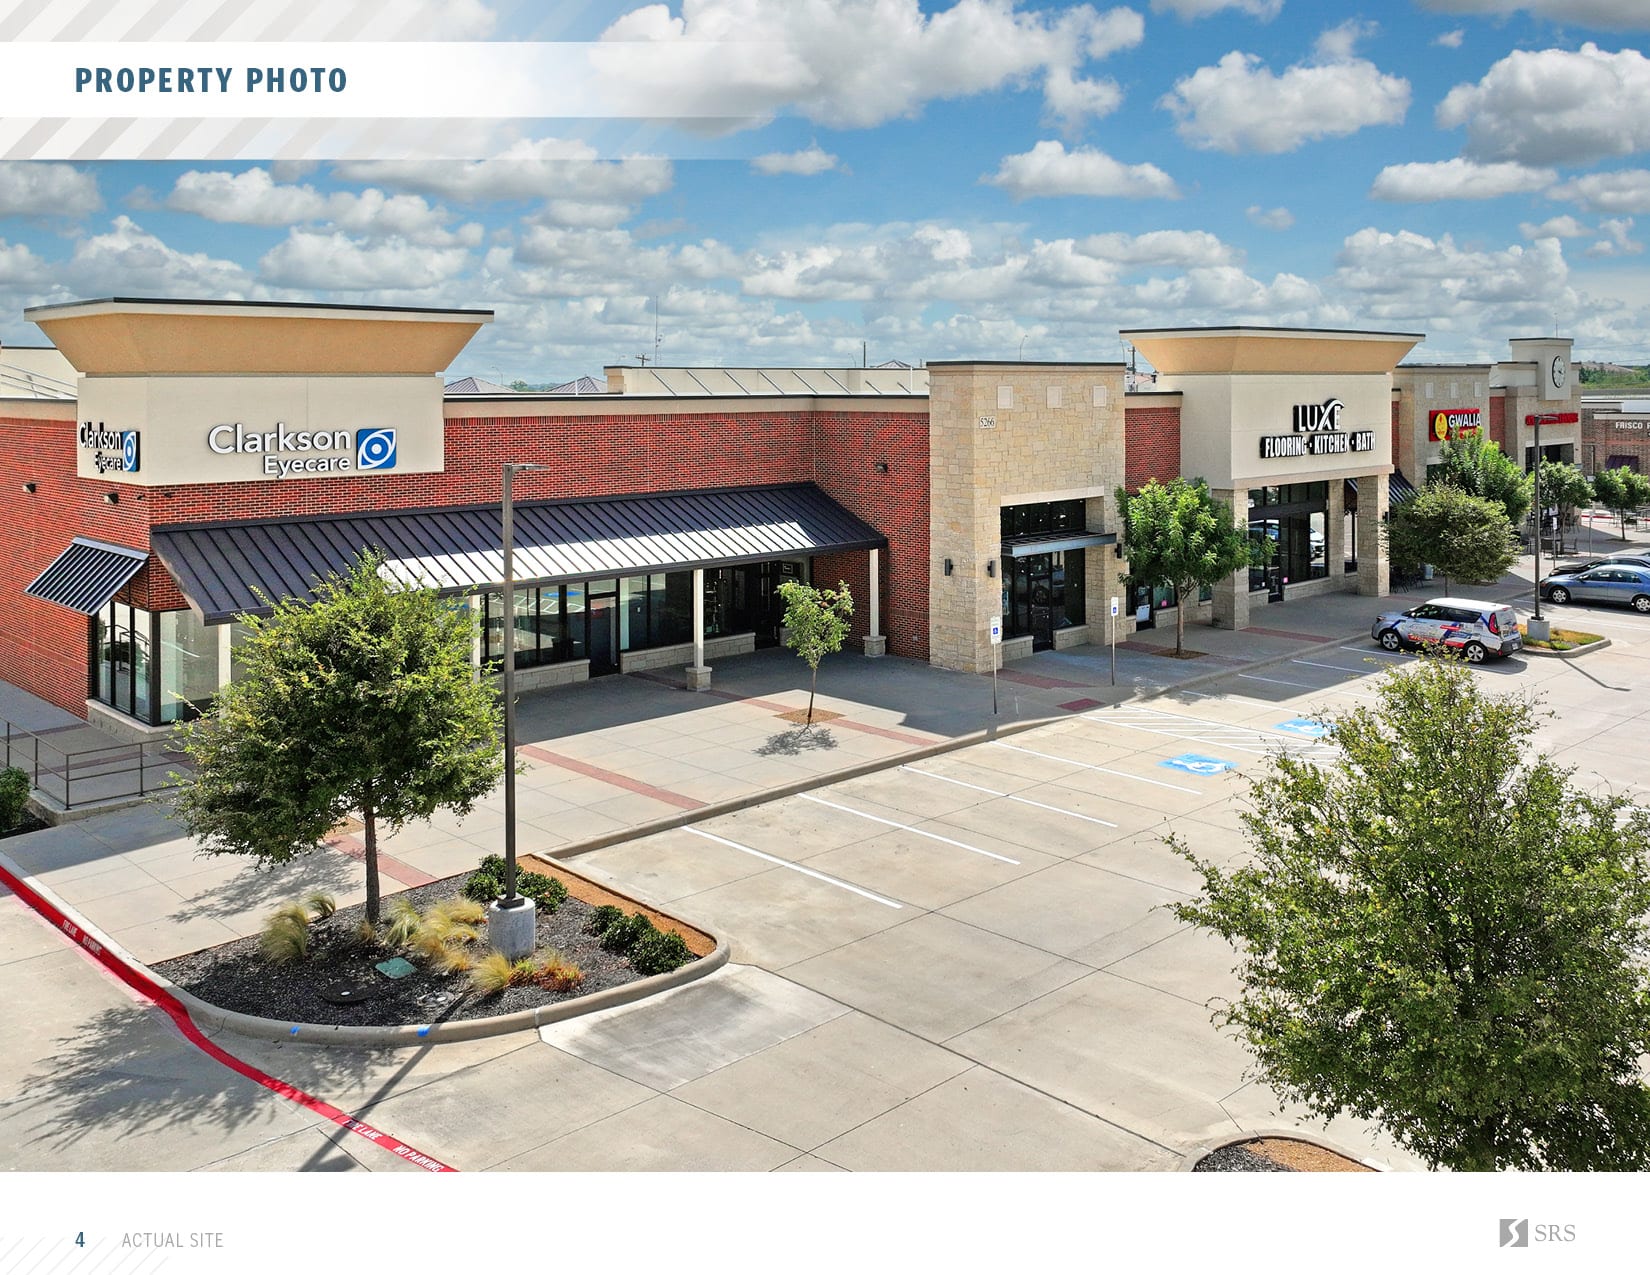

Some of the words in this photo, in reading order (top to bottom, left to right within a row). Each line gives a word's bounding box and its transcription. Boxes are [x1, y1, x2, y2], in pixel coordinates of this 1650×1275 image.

[1294, 398, 1344, 432] LUXE
[1448, 413, 1481, 428] GWALIA
[1615, 421, 1643, 429] FRISCO
[79, 421, 122, 450] Clarkson
[208, 422, 351, 454] Clarkson
[1262, 435, 1306, 458] FLOORING
[1312, 433, 1350, 454] KITCHEN
[1355, 431, 1375, 451] BATH
[95, 451, 122, 473] Eyecare
[263, 455, 351, 478] Eyecare
[342, 1119, 364, 1131] FIRE
[358, 1125, 383, 1140] LANE
[392, 1144, 411, 1156] NO
[407, 1150, 445, 1172] PARKING
